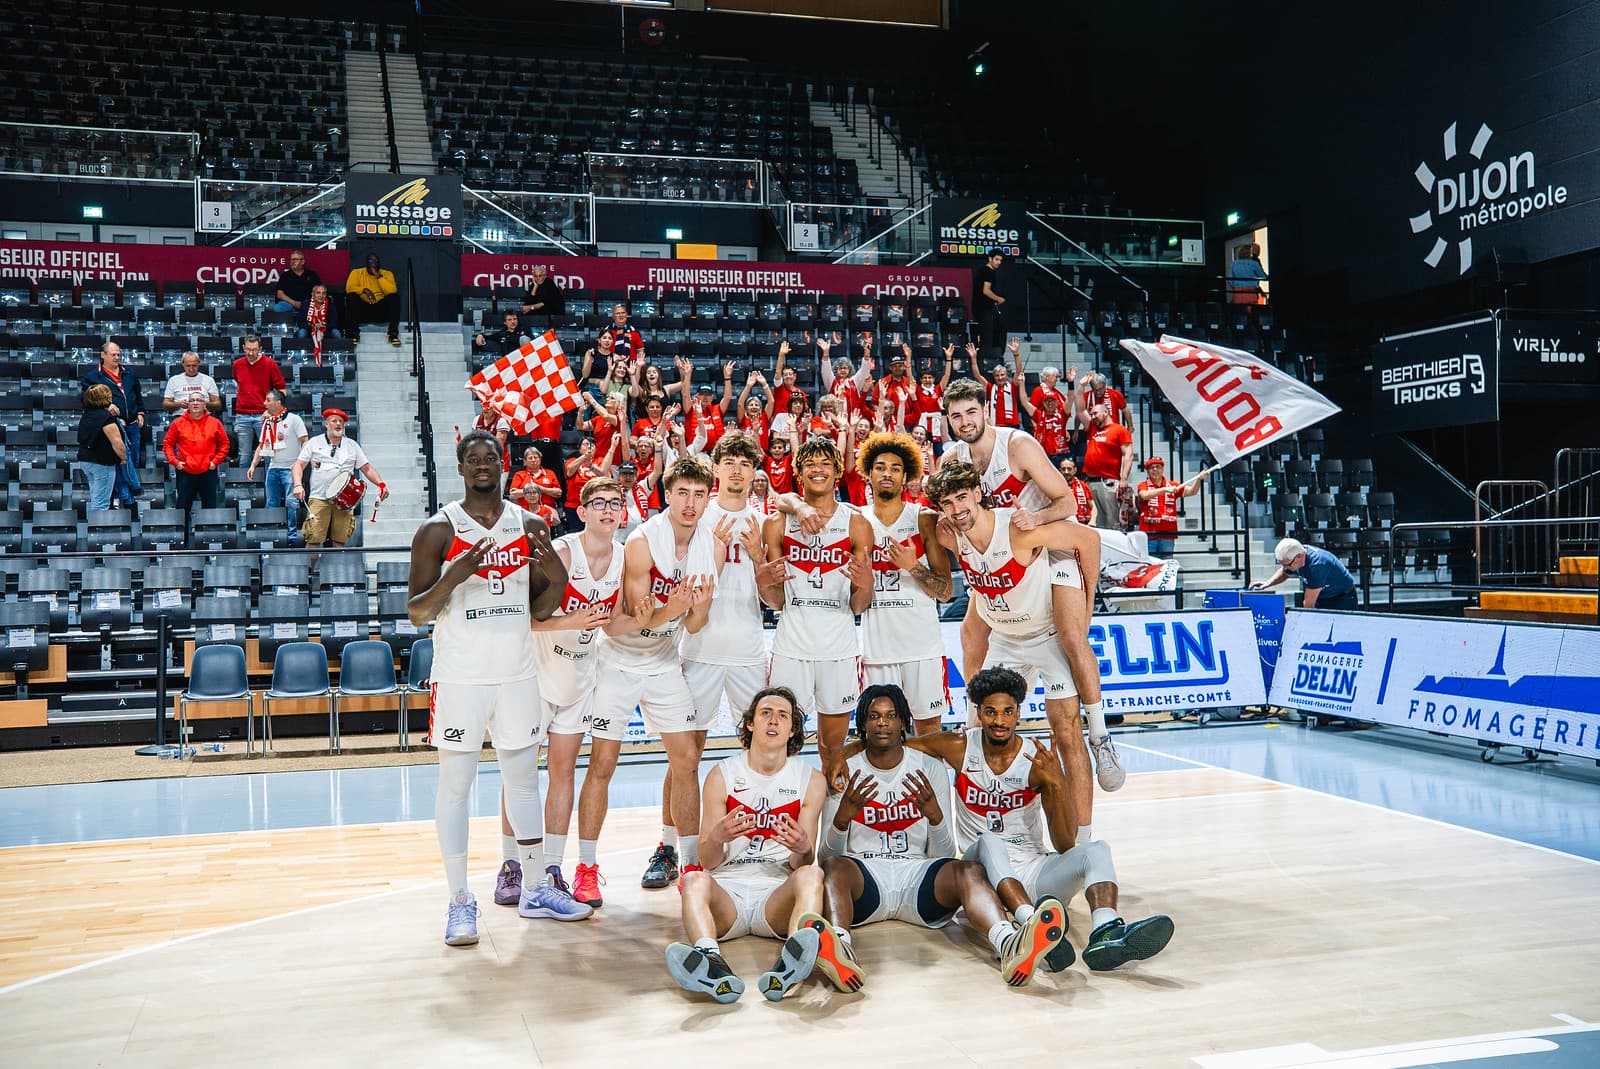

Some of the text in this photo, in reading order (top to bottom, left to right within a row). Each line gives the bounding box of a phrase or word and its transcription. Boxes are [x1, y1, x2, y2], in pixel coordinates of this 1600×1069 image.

[80, 164, 107, 174] BLOC 3
[663, 189, 686, 198] BLOC 2
[213, 207, 220, 217] 3
[356, 204, 452, 222] message
[1460, 185, 1568, 231] métropole
[803, 229, 809, 238] 2
[941, 226, 1019, 242] message
[1190, 244, 1194, 252] 1
[0, 248, 124, 269] SEUR OFFICIEL
[229, 257, 286, 265] GROUPE
[196, 266, 290, 285] CHOPA
[473, 273, 585, 291] CHOPRD
[648, 268, 805, 287] FOURNISSEUR OFFICIEL
[888, 274, 934, 282] GROUPE
[862, 284, 960, 301] CHOPARD
[1513, 338, 1561, 352] VIRLY
[1381, 357, 1461, 385] BERTHIER
[1393, 382, 1462, 405] TRUCKS
[789, 545, 842, 565] BOURG
[488, 570, 504, 596] 6
[807, 566, 823, 589] 4
[875, 569, 900, 592] 12
[982, 593, 1011, 612] 14
[1088, 620, 1218, 677] ELIN
[1297, 652, 1364, 669] FROMAGERIE
[1295, 664, 1358, 697] DELIN
[119, 698, 127, 706] A
[842, 695, 856, 704] AIN
[930, 700, 943, 709] AIN
[965, 785, 1024, 809] BOURG
[864, 800, 922, 825] BOURG
[746, 834, 766, 855] 9
[879, 830, 909, 854] 13
